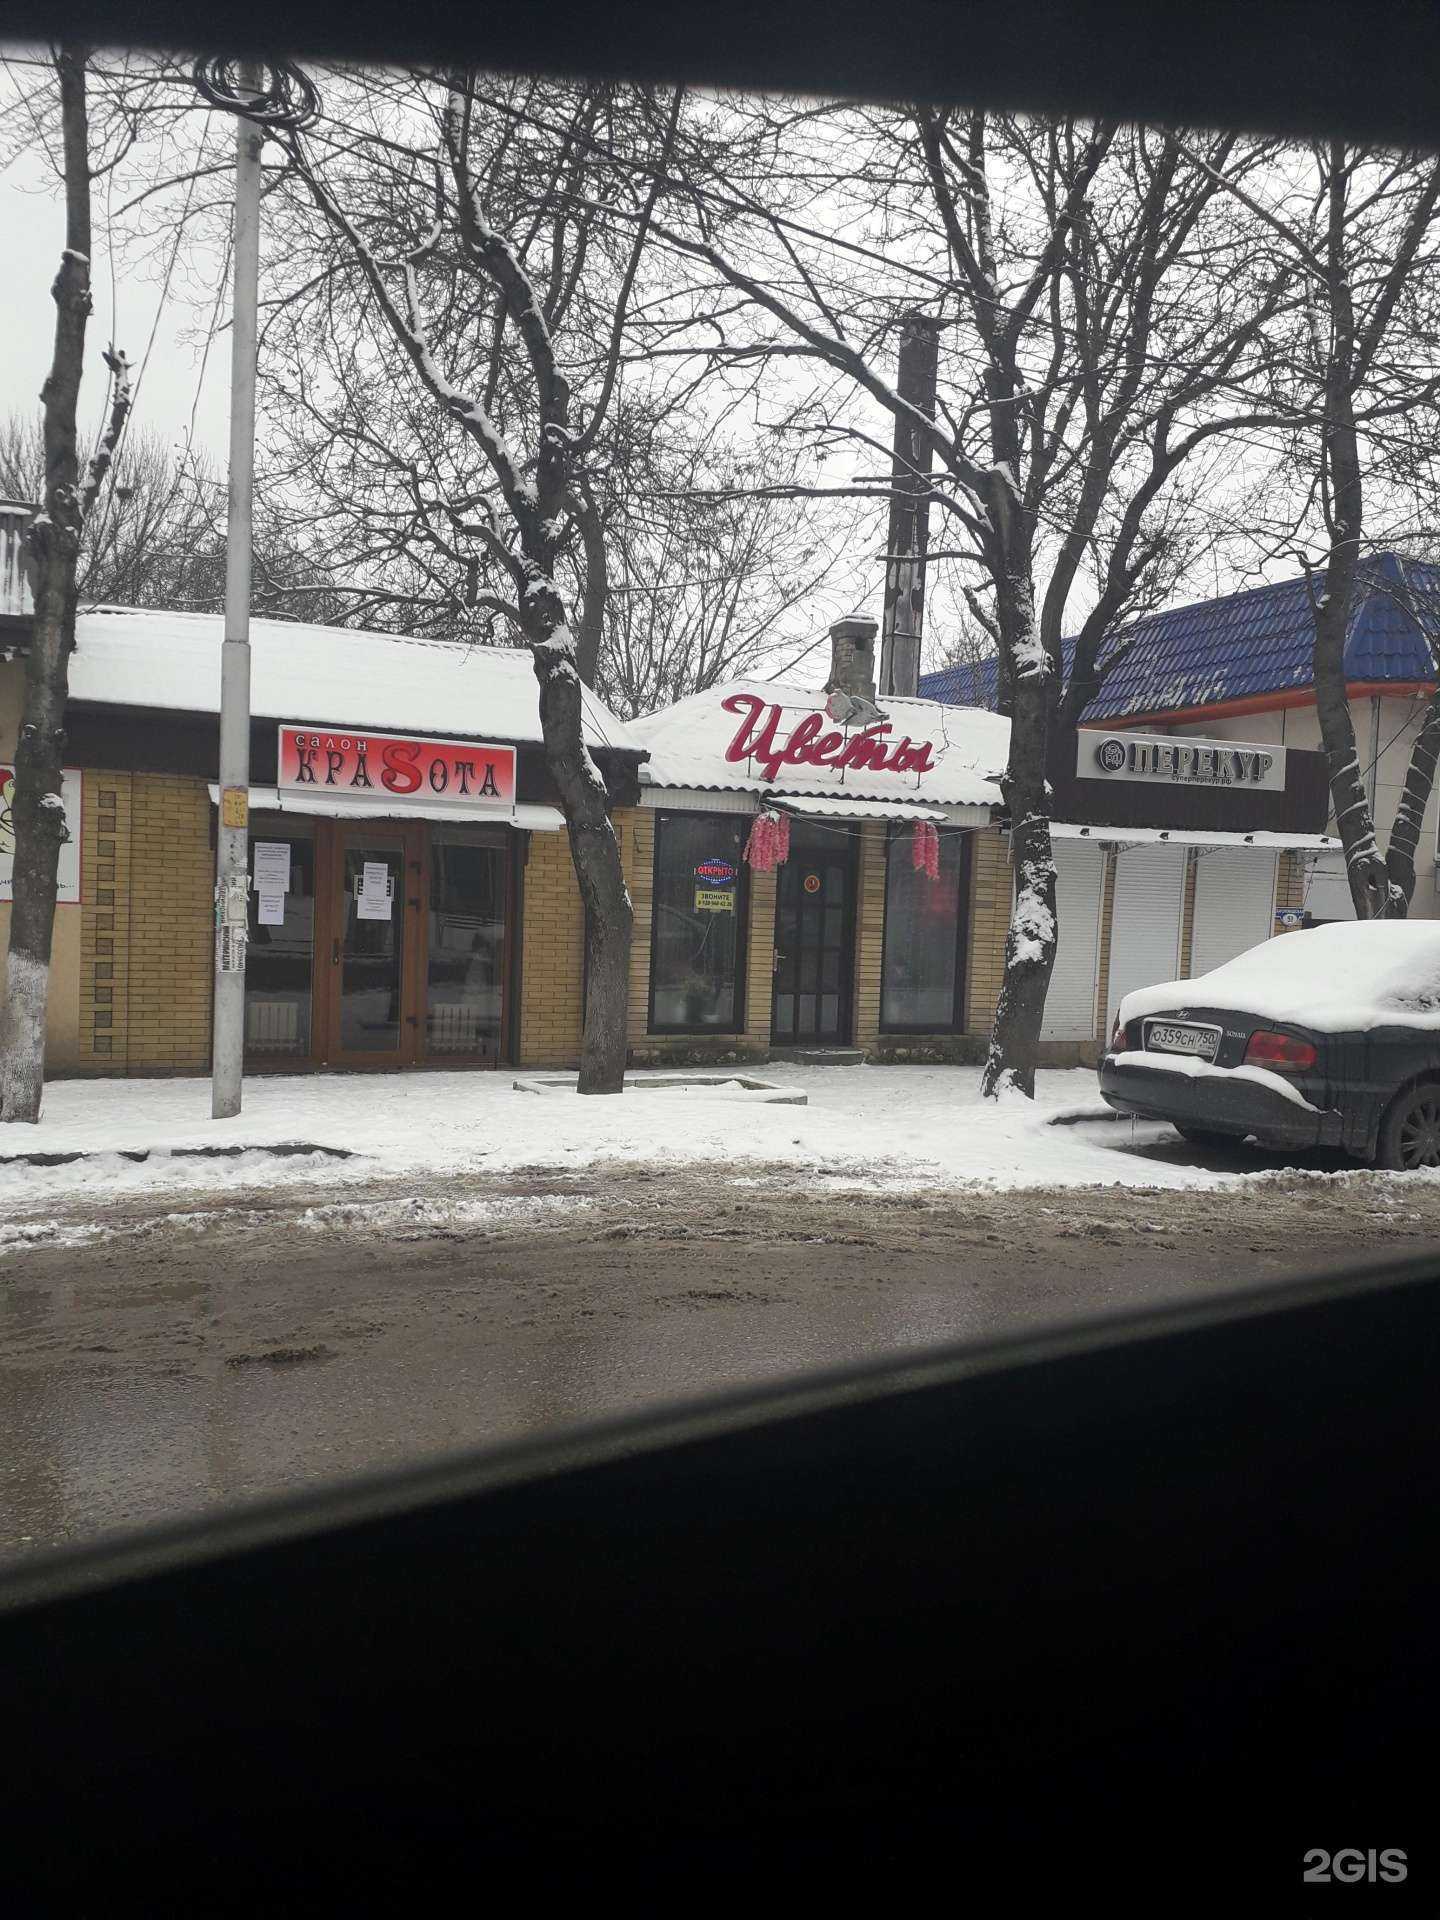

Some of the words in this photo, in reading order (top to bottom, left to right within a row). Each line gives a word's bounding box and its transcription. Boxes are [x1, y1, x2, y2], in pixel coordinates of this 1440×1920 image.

[295, 735, 367, 752] салон
[721, 694, 935, 783] Цветы
[1133, 741, 1273, 781] ПЕРЕКУР
[698, 866, 734, 876] ОТКРЫТО
[1197, 1032, 1215, 1044] 750
